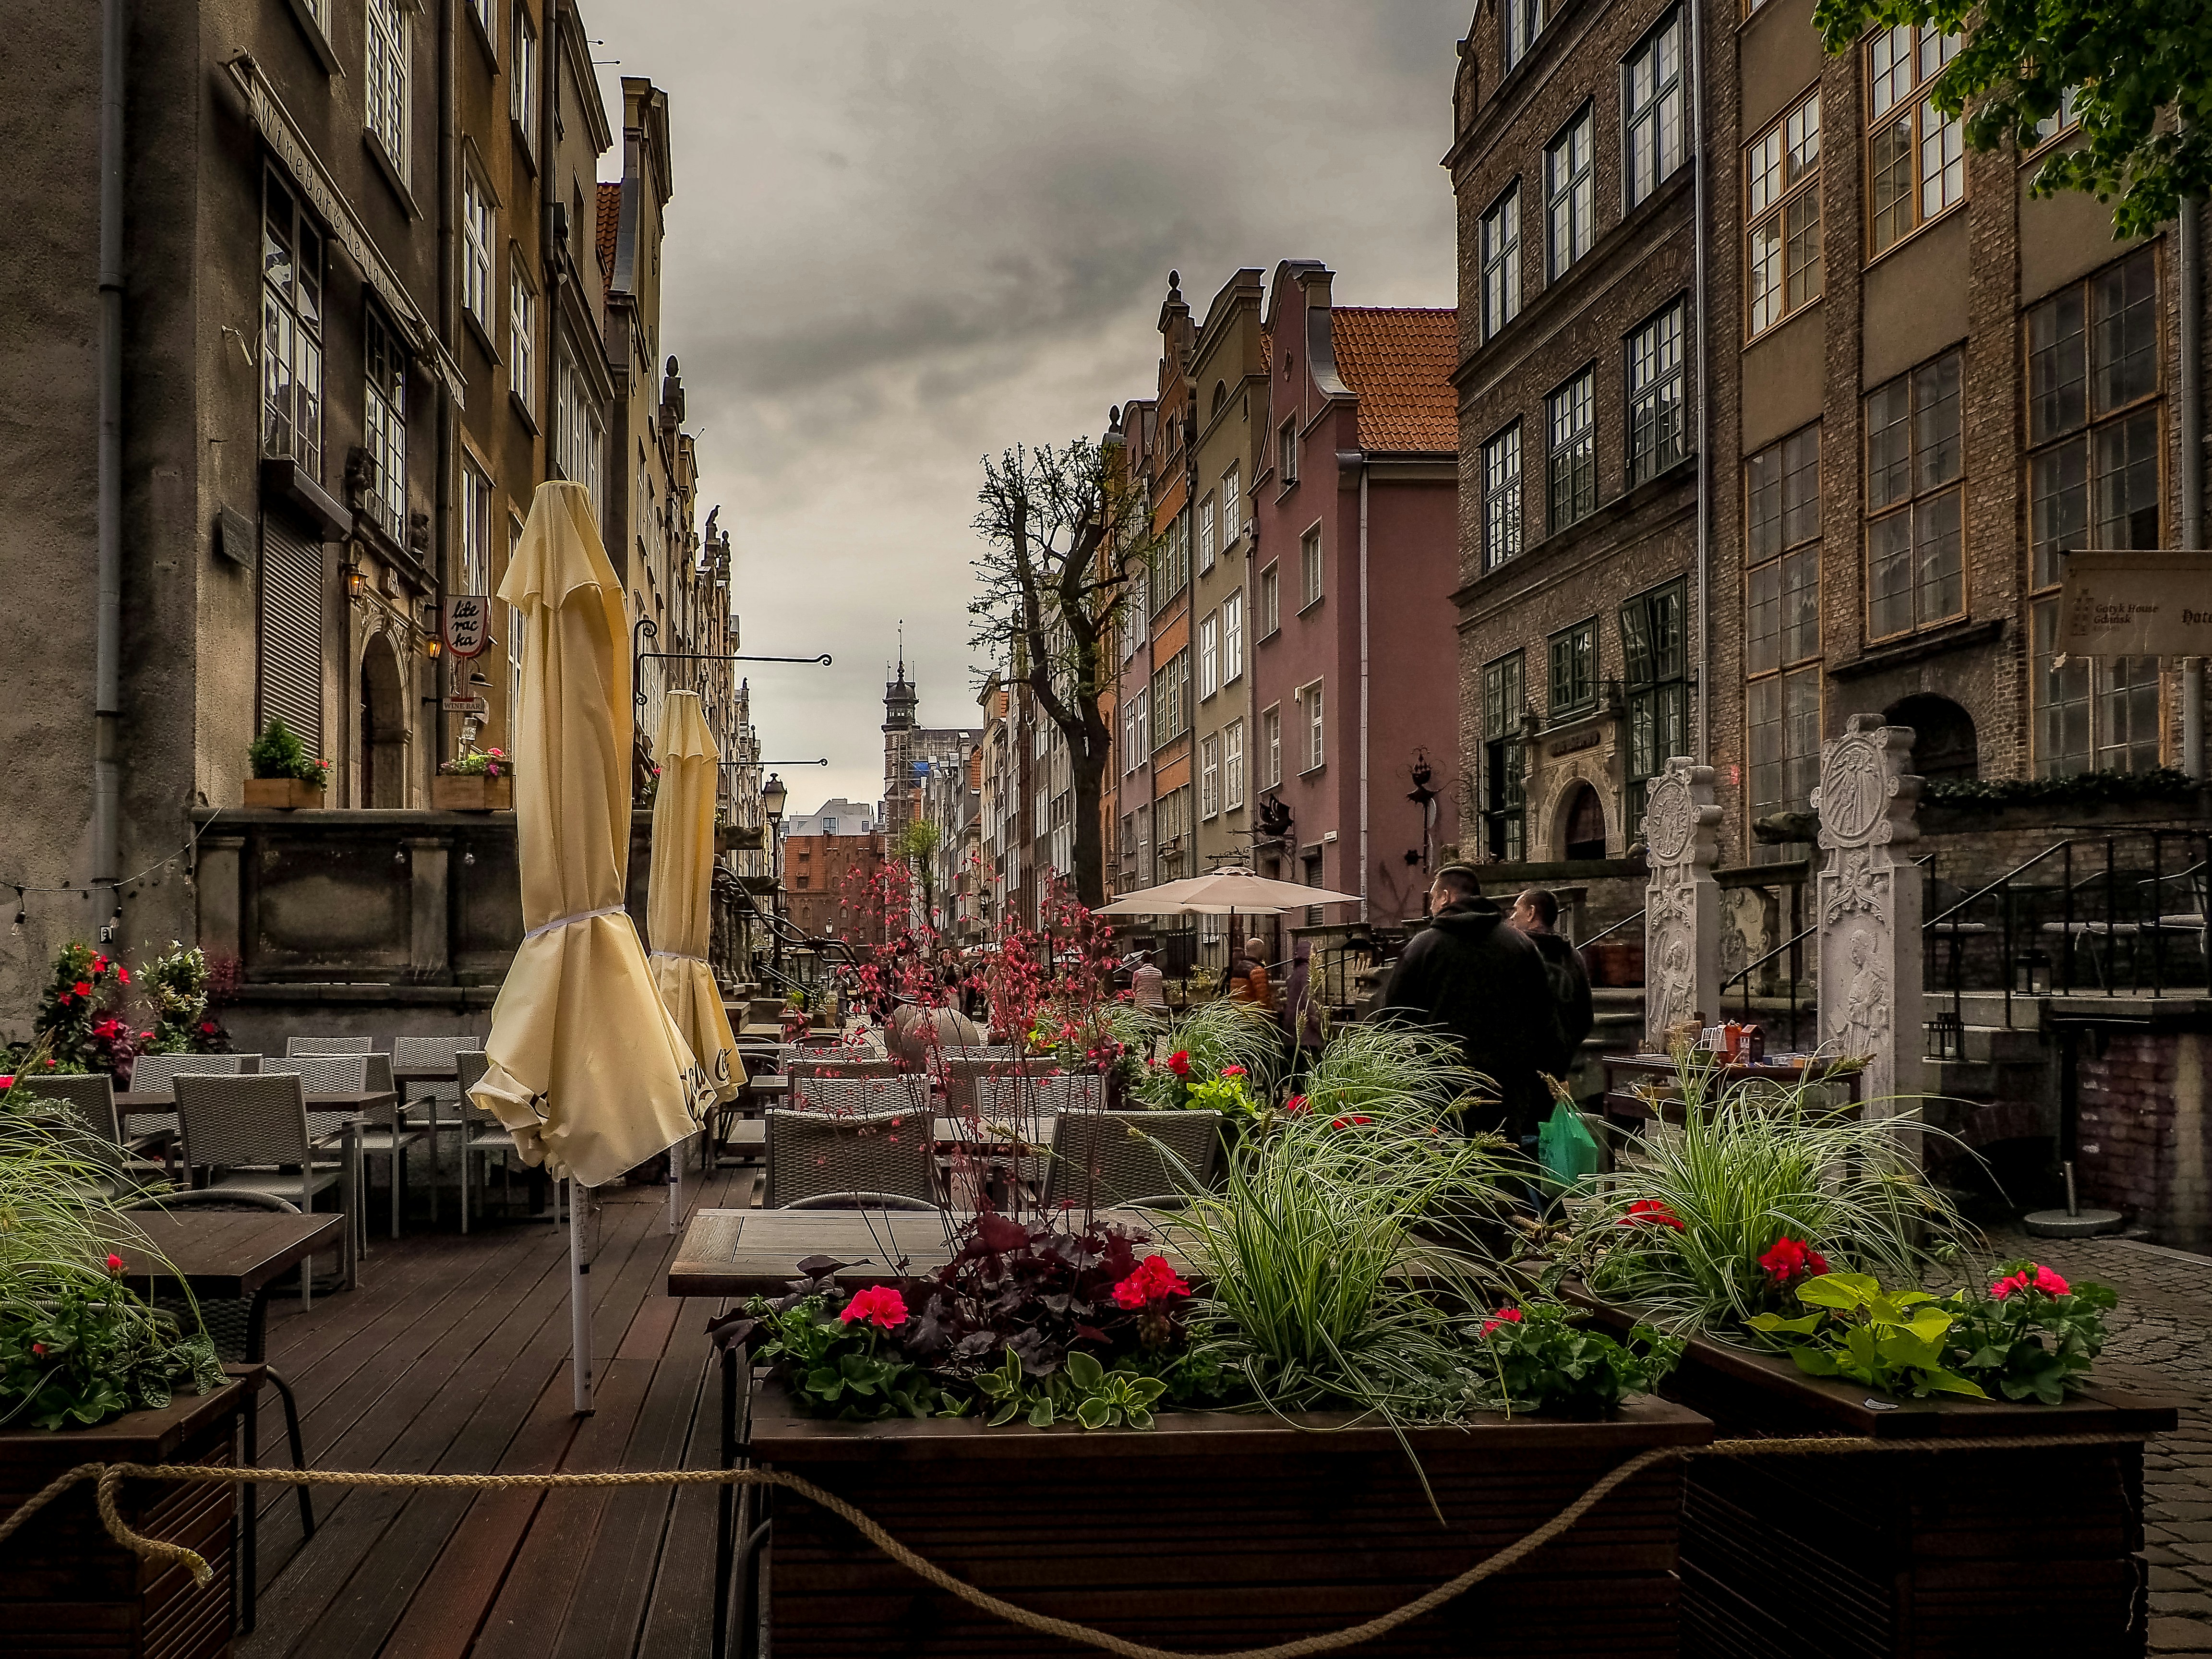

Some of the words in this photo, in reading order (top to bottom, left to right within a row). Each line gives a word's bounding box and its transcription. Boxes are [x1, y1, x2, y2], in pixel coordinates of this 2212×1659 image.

[262, 95, 302, 176] Wine
[305, 161, 331, 216] Bar
[451, 600, 479, 618] lite
[2095, 603, 2124, 615] Gotyk
[2127, 604, 2159, 613] House
[451, 621, 478, 632] rac
[452, 633, 478, 647] ka
